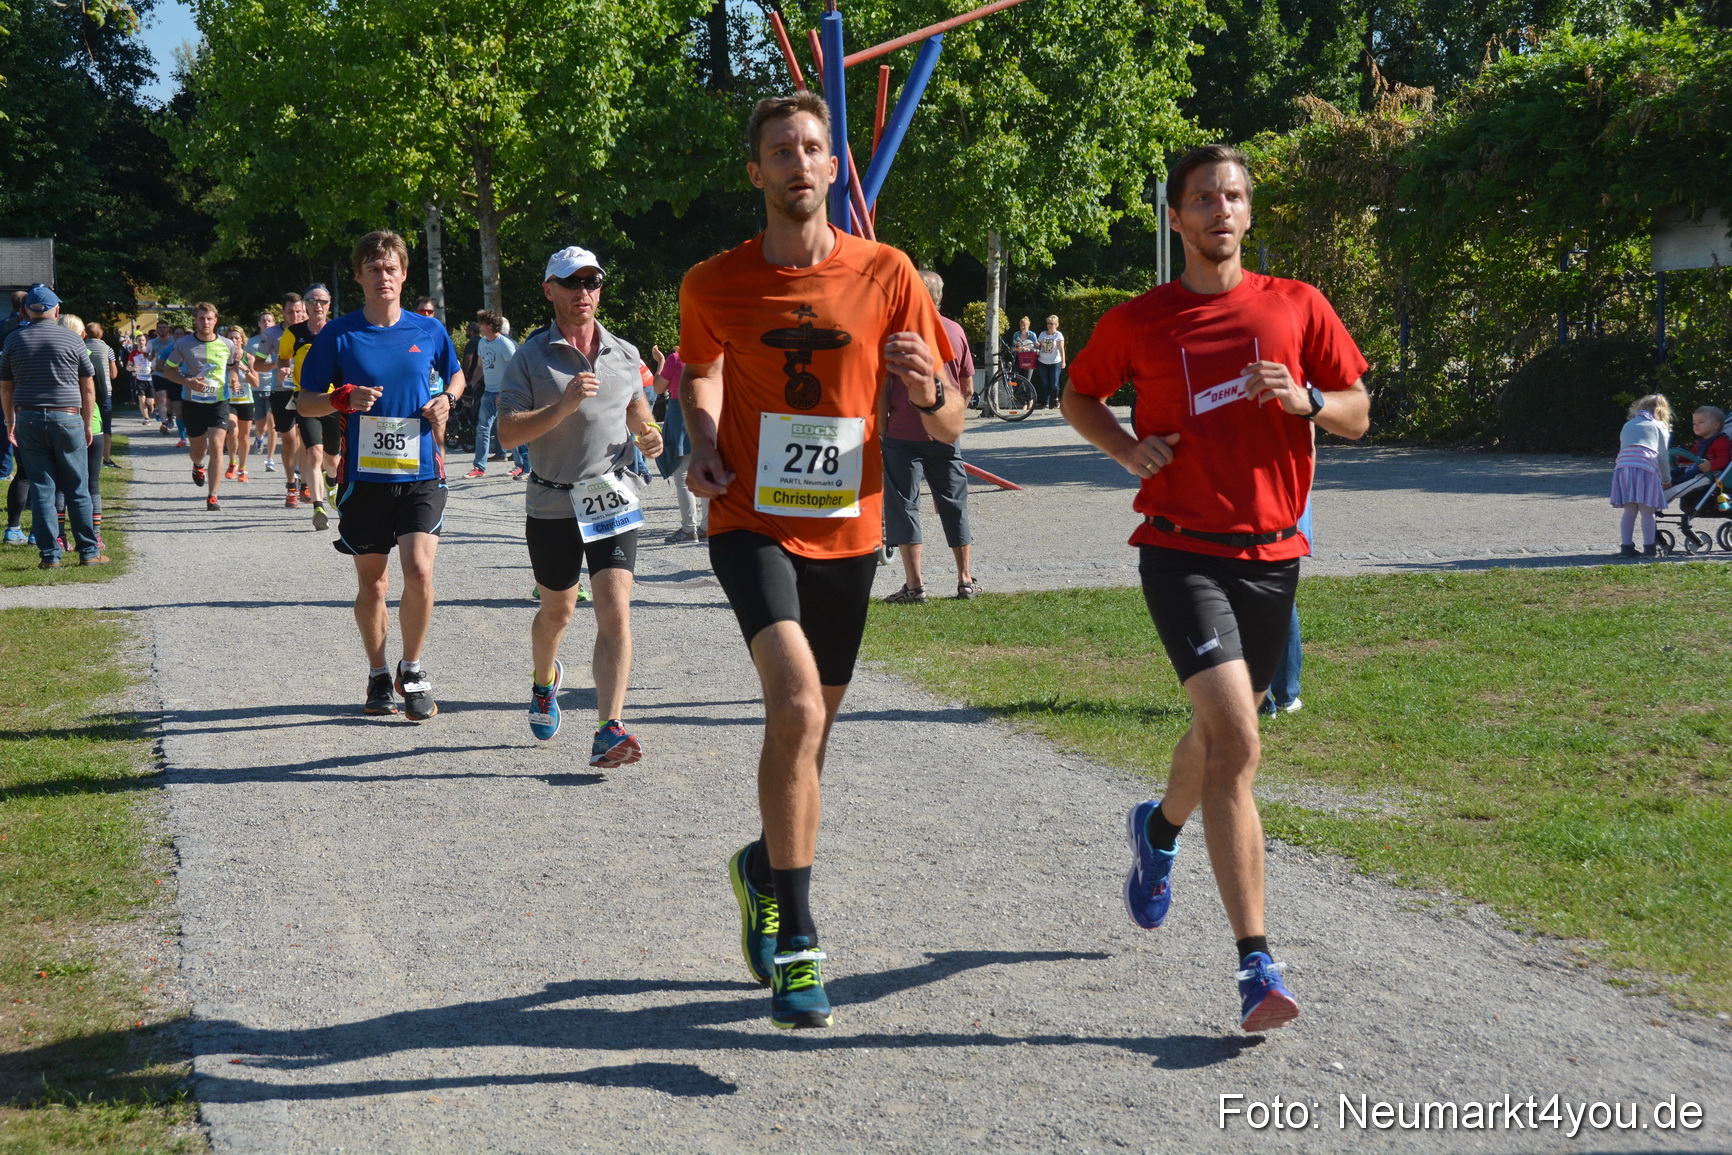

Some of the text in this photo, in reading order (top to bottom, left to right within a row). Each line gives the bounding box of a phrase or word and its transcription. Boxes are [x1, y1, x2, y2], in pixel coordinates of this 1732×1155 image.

[1211, 385, 1238, 402] DEHN
[791, 423, 837, 436] BOCK
[374, 432, 405, 450] 365
[783, 442, 839, 475] 278
[780, 477, 834, 487] PARTL Neumarkt
[773, 490, 843, 508] Christopher
[596, 517, 630, 533] Christian
